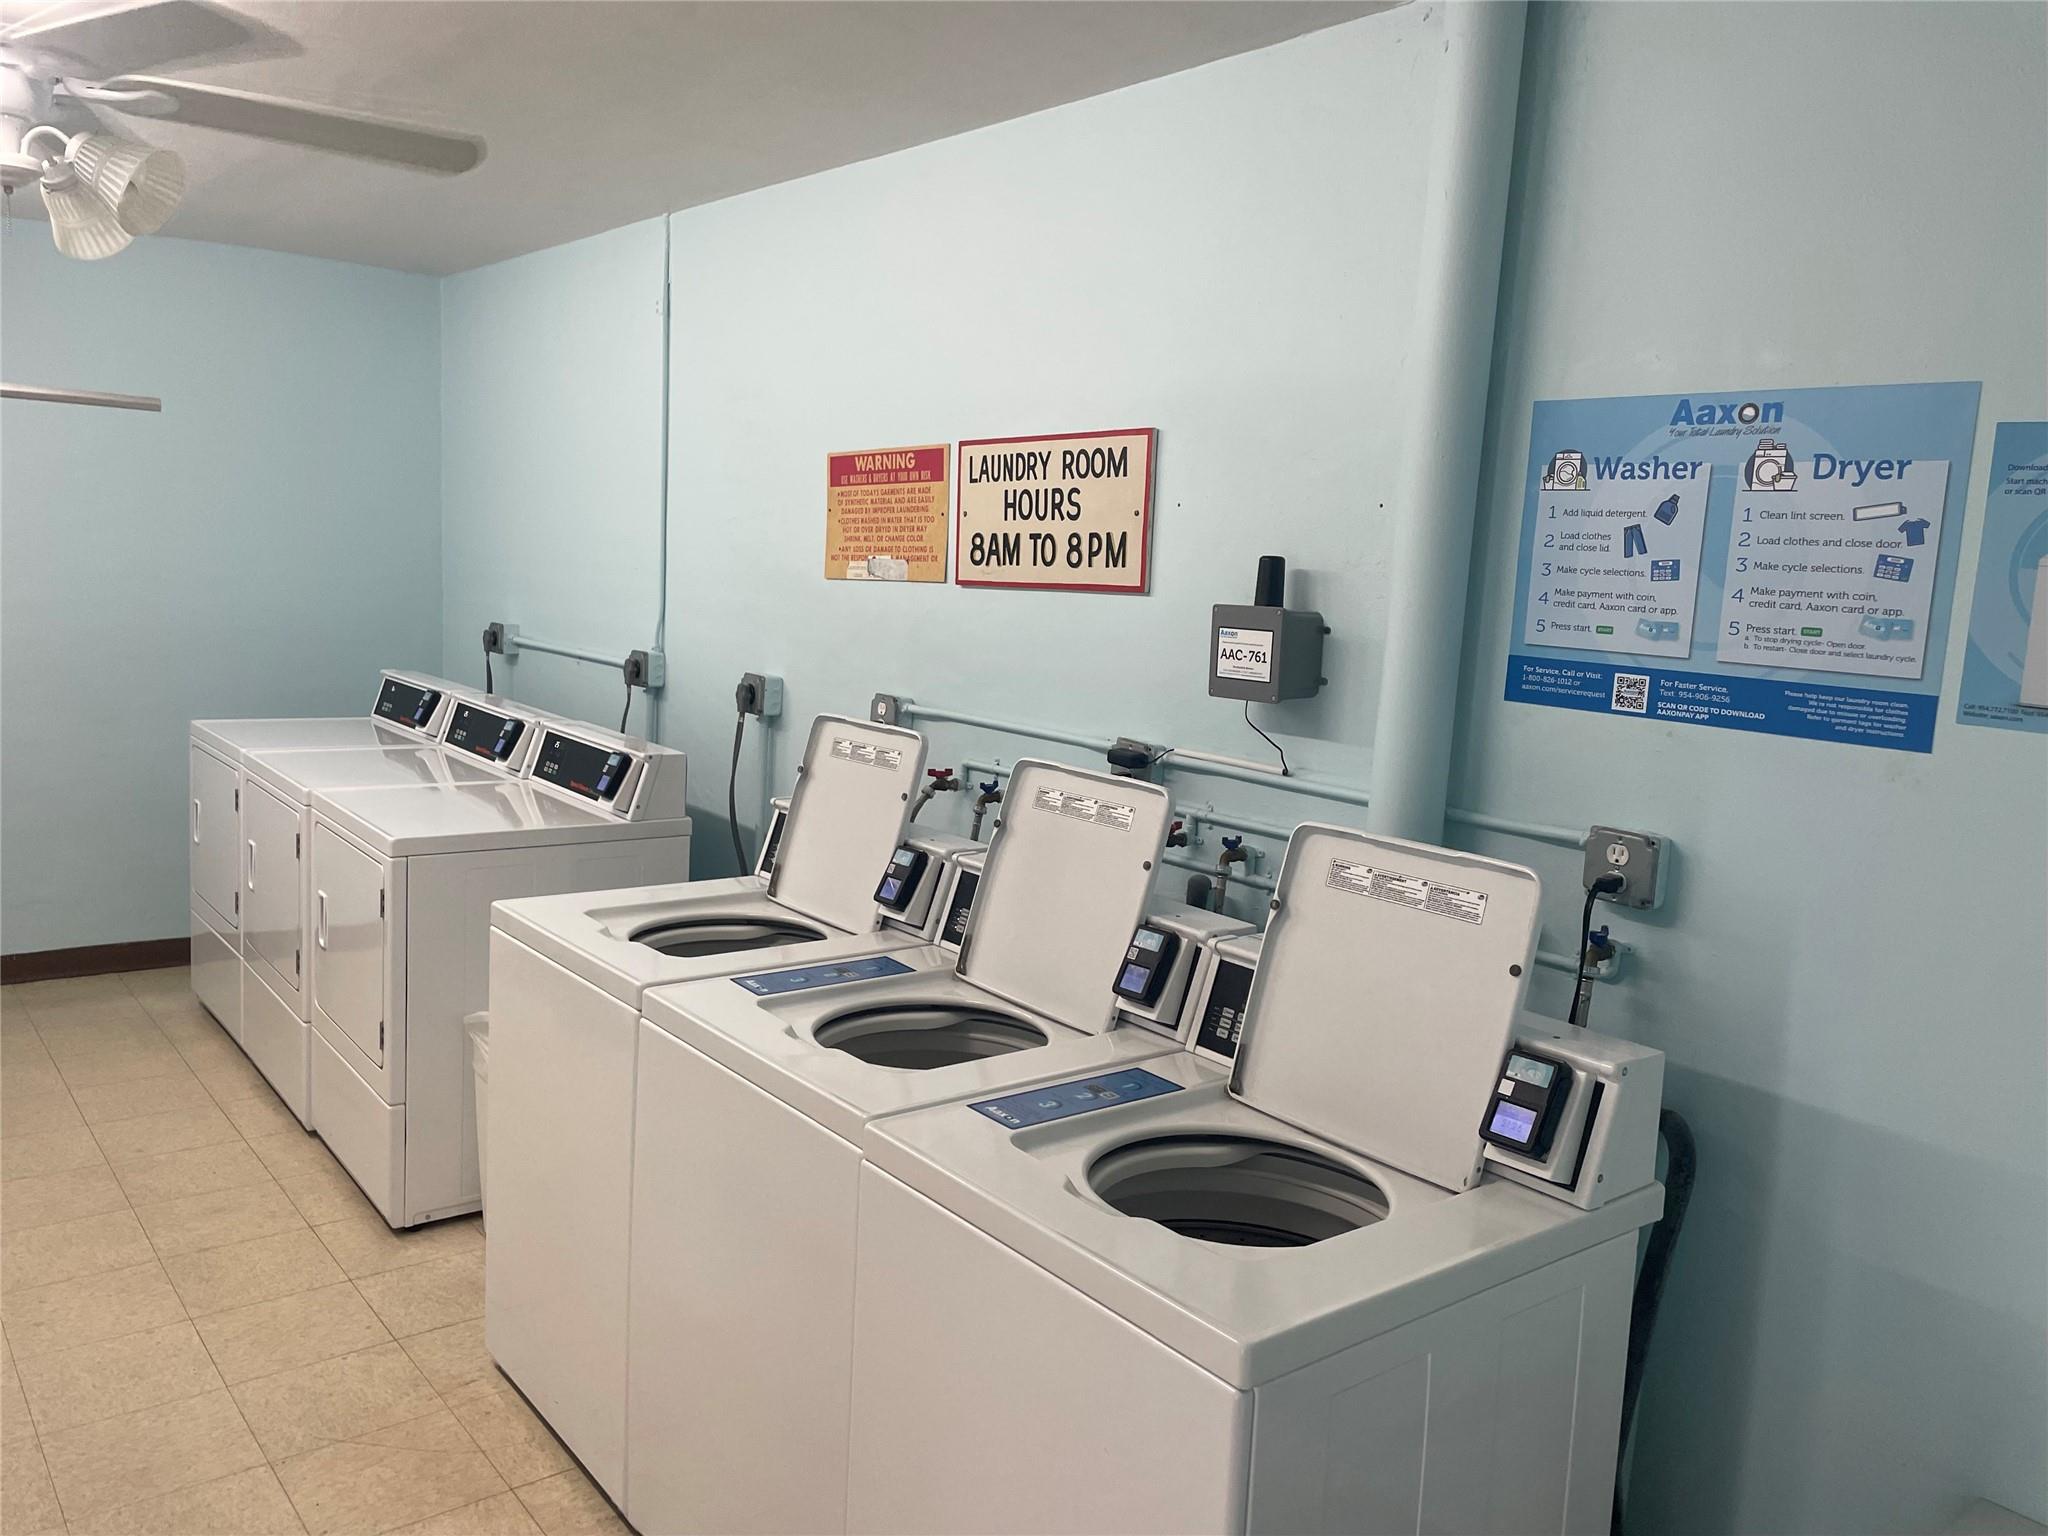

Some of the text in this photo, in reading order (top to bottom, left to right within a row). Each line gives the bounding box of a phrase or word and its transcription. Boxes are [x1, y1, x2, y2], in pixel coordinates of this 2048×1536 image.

[1670, 399, 1784, 425] Aaxon
[1669, 426, 1781, 438] Your Total Laundry Solution
[855, 452, 915, 471] WARNING
[969, 451, 1051, 483] LAUNDRY
[1062, 447, 1127, 480] ROOM
[1594, 456, 1702, 480] Washer
[1813, 454, 1912, 487] Dryer
[1004, 487, 1082, 521] HOURS
[1548, 506, 1647, 520] 1 Add liquid detergent.
[1742, 508, 1845, 522] 1 Clean lint screen.
[1544, 532, 1611, 547] 2 Load clothes
[1738, 532, 1903, 549] 2 Load clothes and close door.
[970, 532, 1020, 566] 8AM
[1029, 533, 1056, 567] TO
[1559, 543, 1574, 551] and
[1576, 544, 1597, 552] close
[1541, 563, 1646, 578] 3 Make cycle selections.
[1736, 557, 1864, 575] 3 Make cycle selections.
[1538, 588, 1656, 604] 4 Make payment with coin,
[1731, 588, 1744, 603] 4
[1750, 586, 1776, 596] Make
[1779, 588, 1824, 600] payment
[1826, 590, 1850, 601] with
[1553, 599, 1576, 609] credit
[1599, 602, 1626, 612] Aaxon
[1628, 604, 1646, 613] card
[1660, 606, 1679, 616] app.
[1749, 599, 1777, 609] credit
[1806, 602, 1839, 613] Aaxon
[1841, 604, 1865, 615] card
[1867, 607, 1879, 615] or
[1882, 608, 1904, 618] app.
[1536, 619, 1545, 632] 5
[1551, 621, 1572, 631] Press
[1573, 623, 1592, 632] start.
[1728, 621, 1740, 636] 5
[1746, 623, 1771, 634] Press
[1773, 625, 1797, 636] start.
[1764, 635, 1779, 645] stop
[1780, 636, 1802, 647] drying
[1826, 641, 1846, 650] Open
[1848, 642, 1866, 650] door.
[1220, 648, 1267, 663] AAC-761
[1810, 648, 1826, 656] door
[1866, 652, 1894, 663] laundry
[1895, 654, 1917, 664] cycle.
[1523, 674, 1572, 686] 1-800-826-1012
[1674, 681, 1697, 689] Faster
[1522, 684, 1605, 698] aaxon.com/servicerequest
[1678, 691, 1730, 703] 954-906-9256
[1657, 709, 1694, 719] AAXONPAY
[1689, 705, 1708, 713] CODE
[1721, 709, 1766, 720] DOWNLOAD
